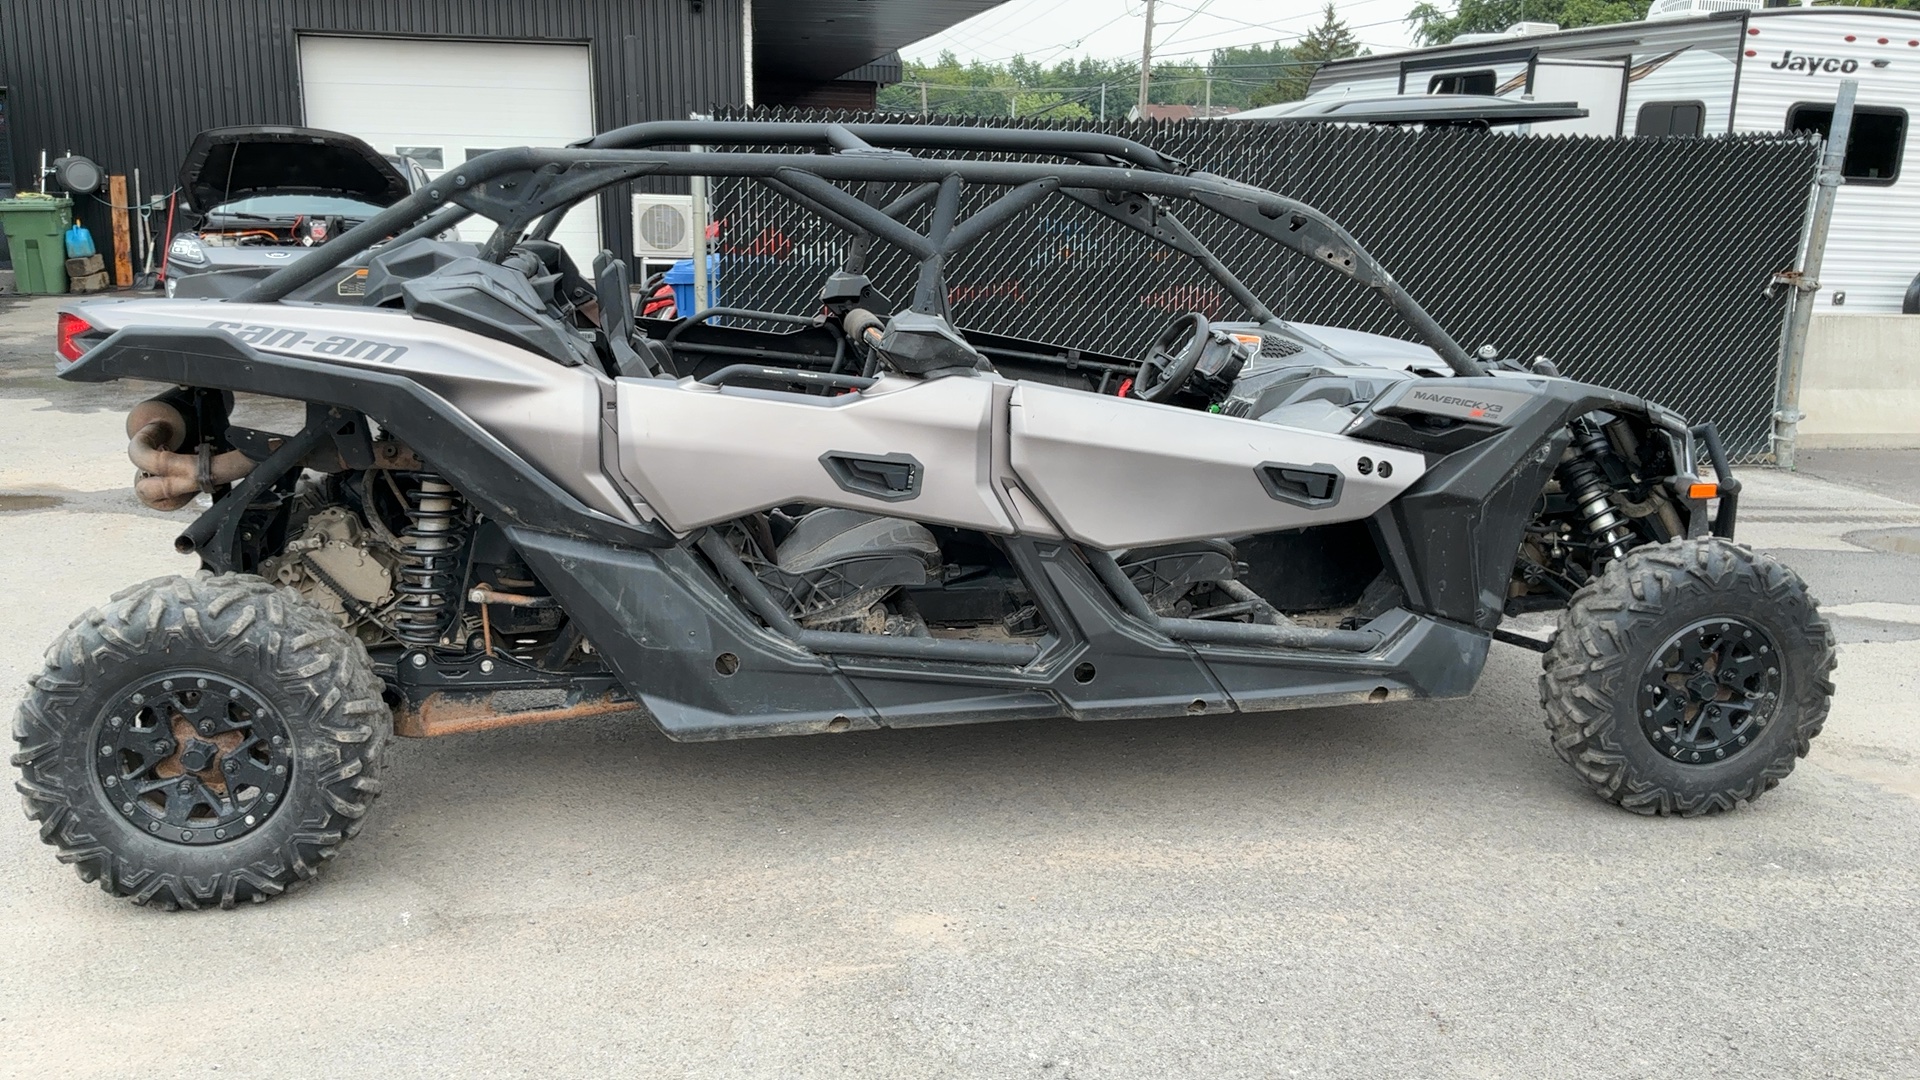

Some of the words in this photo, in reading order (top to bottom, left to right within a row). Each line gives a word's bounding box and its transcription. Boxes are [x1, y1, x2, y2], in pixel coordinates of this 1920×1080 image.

[1770, 50, 1859, 76] Jayco
[1413, 391, 1483, 409] MAVERICK
[1482, 402, 1504, 413] X3
